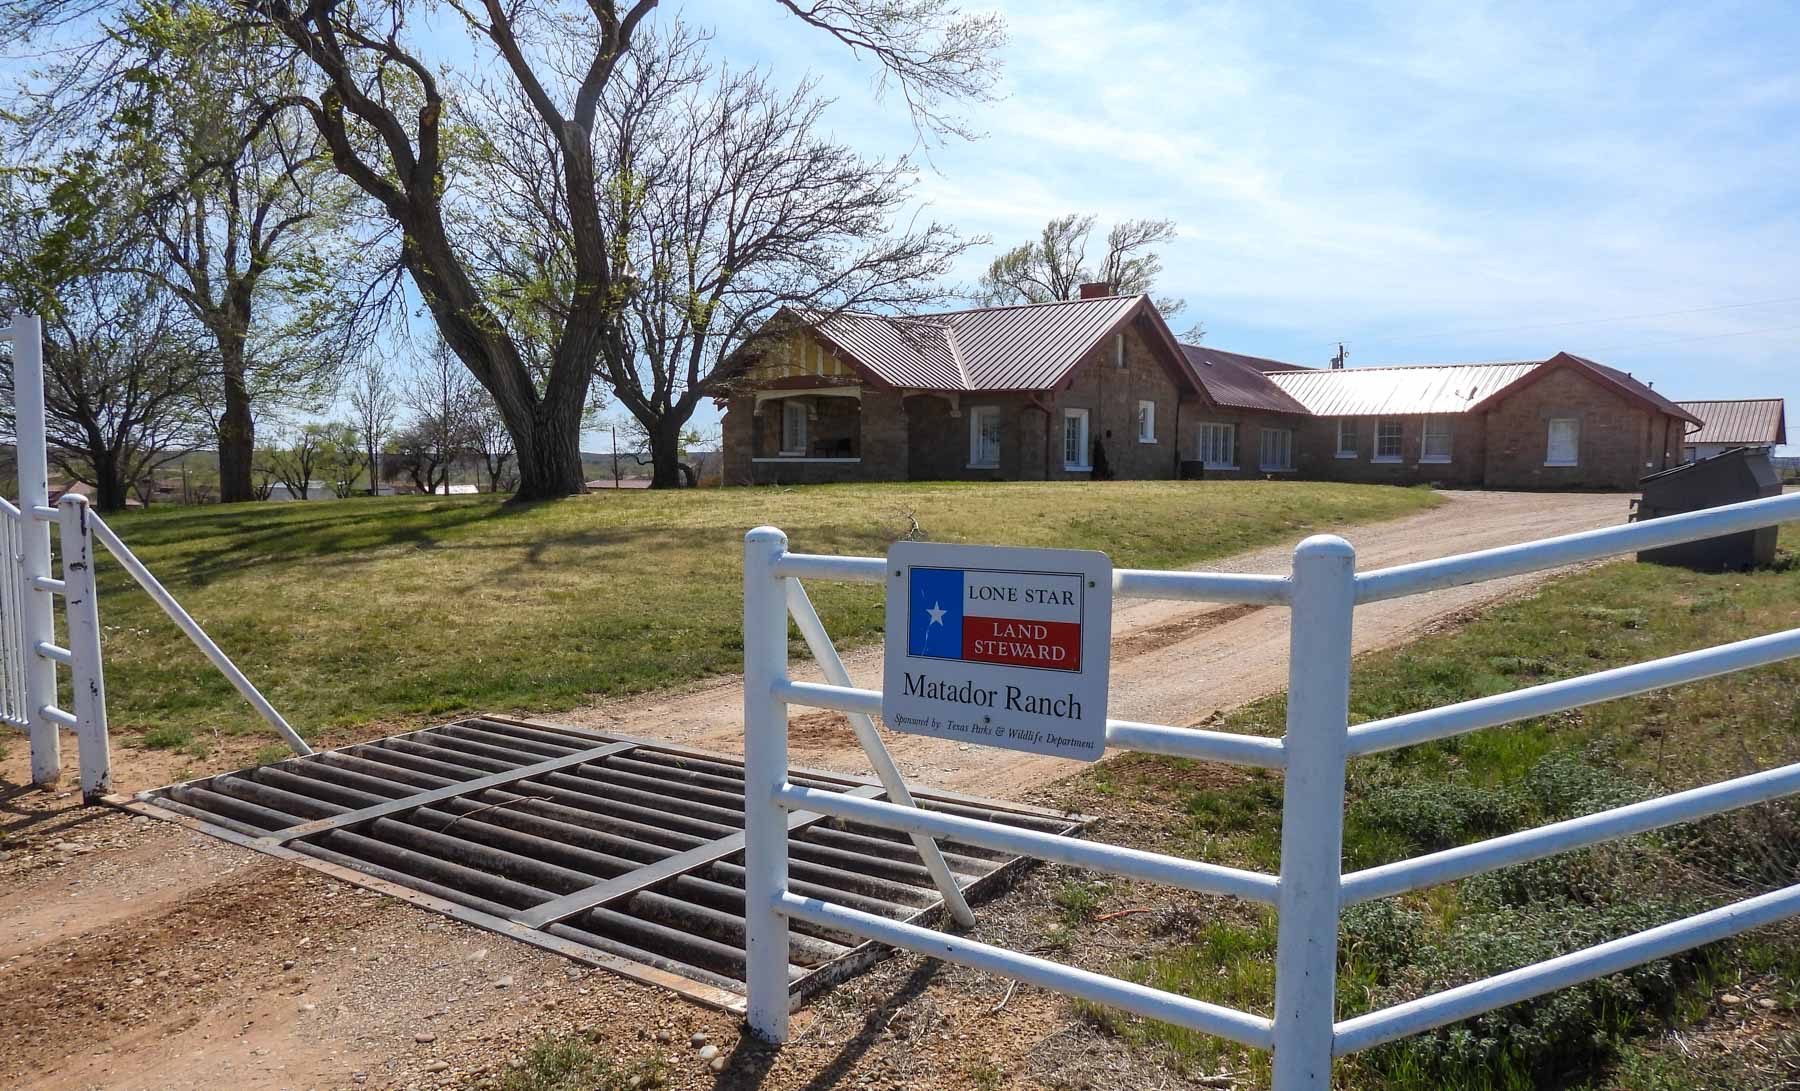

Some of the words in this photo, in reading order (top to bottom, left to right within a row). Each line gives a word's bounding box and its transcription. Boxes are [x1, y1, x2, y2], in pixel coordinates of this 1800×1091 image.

[969, 585, 1018, 602] LONE
[1025, 588, 1075, 606] STAR
[993, 622, 1048, 640] LAND
[974, 639, 1066, 661] STEWARD
[903, 671, 998, 708] Matador
[1005, 685, 1082, 720] Ranch
[894, 713, 930, 727] Sponsored
[931, 718, 941, 731] by
[947, 720, 969, 733] Texas
[971, 723, 993, 736] Parks
[995, 726, 1005, 737] &
[1008, 727, 1043, 745] Wildlife
[1046, 733, 1095, 749] Department
